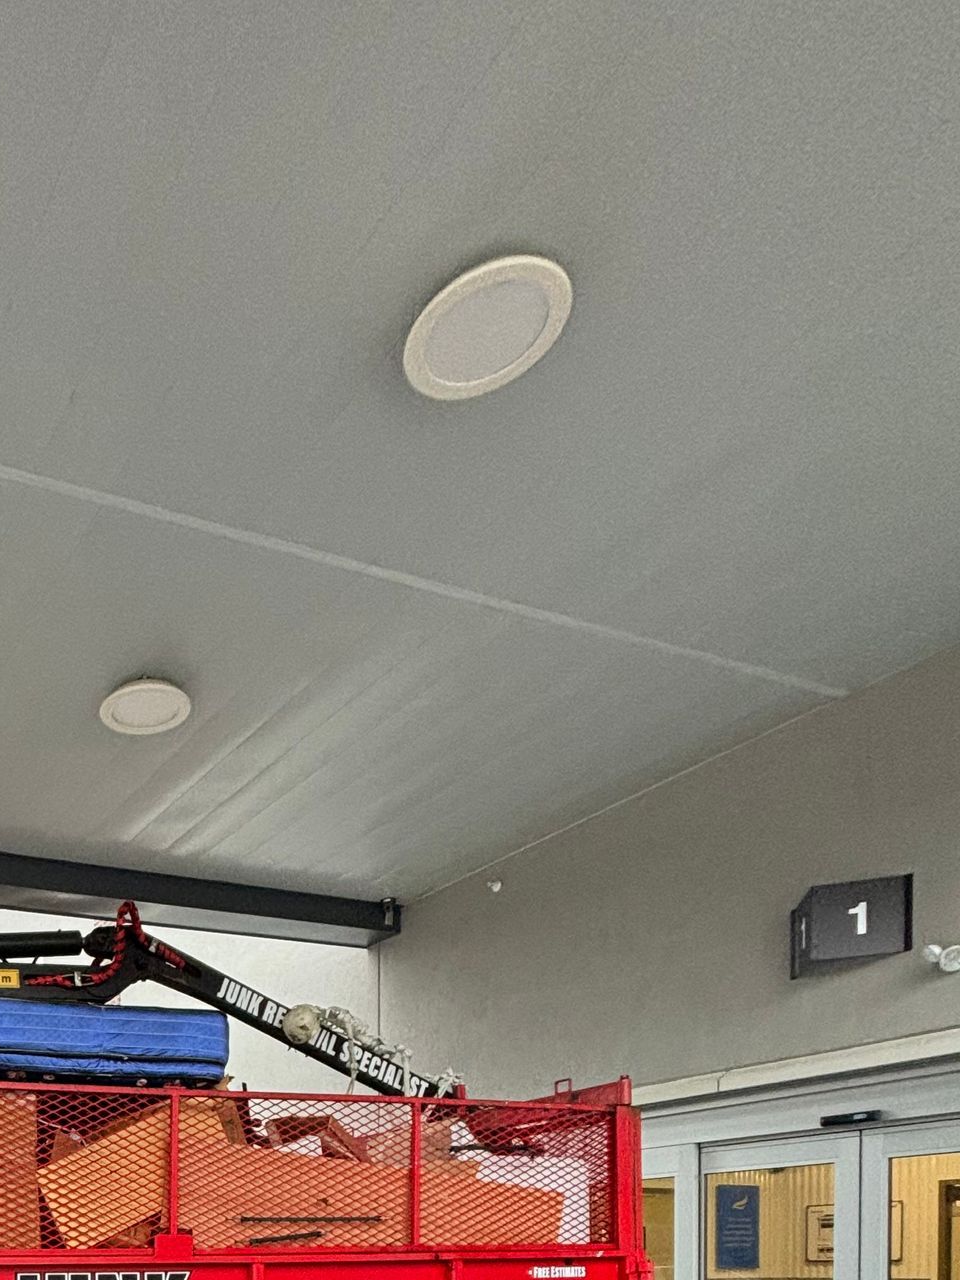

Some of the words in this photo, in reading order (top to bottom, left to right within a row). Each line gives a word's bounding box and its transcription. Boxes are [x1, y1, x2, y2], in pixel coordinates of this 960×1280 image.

[847, 901, 868, 935] 1
[1, 975, 12, 983] m
[217, 977, 265, 1017] JUNK
[533, 1266, 550, 1279] FREE
[550, 1266, 586, 1278] ESTIMATES
